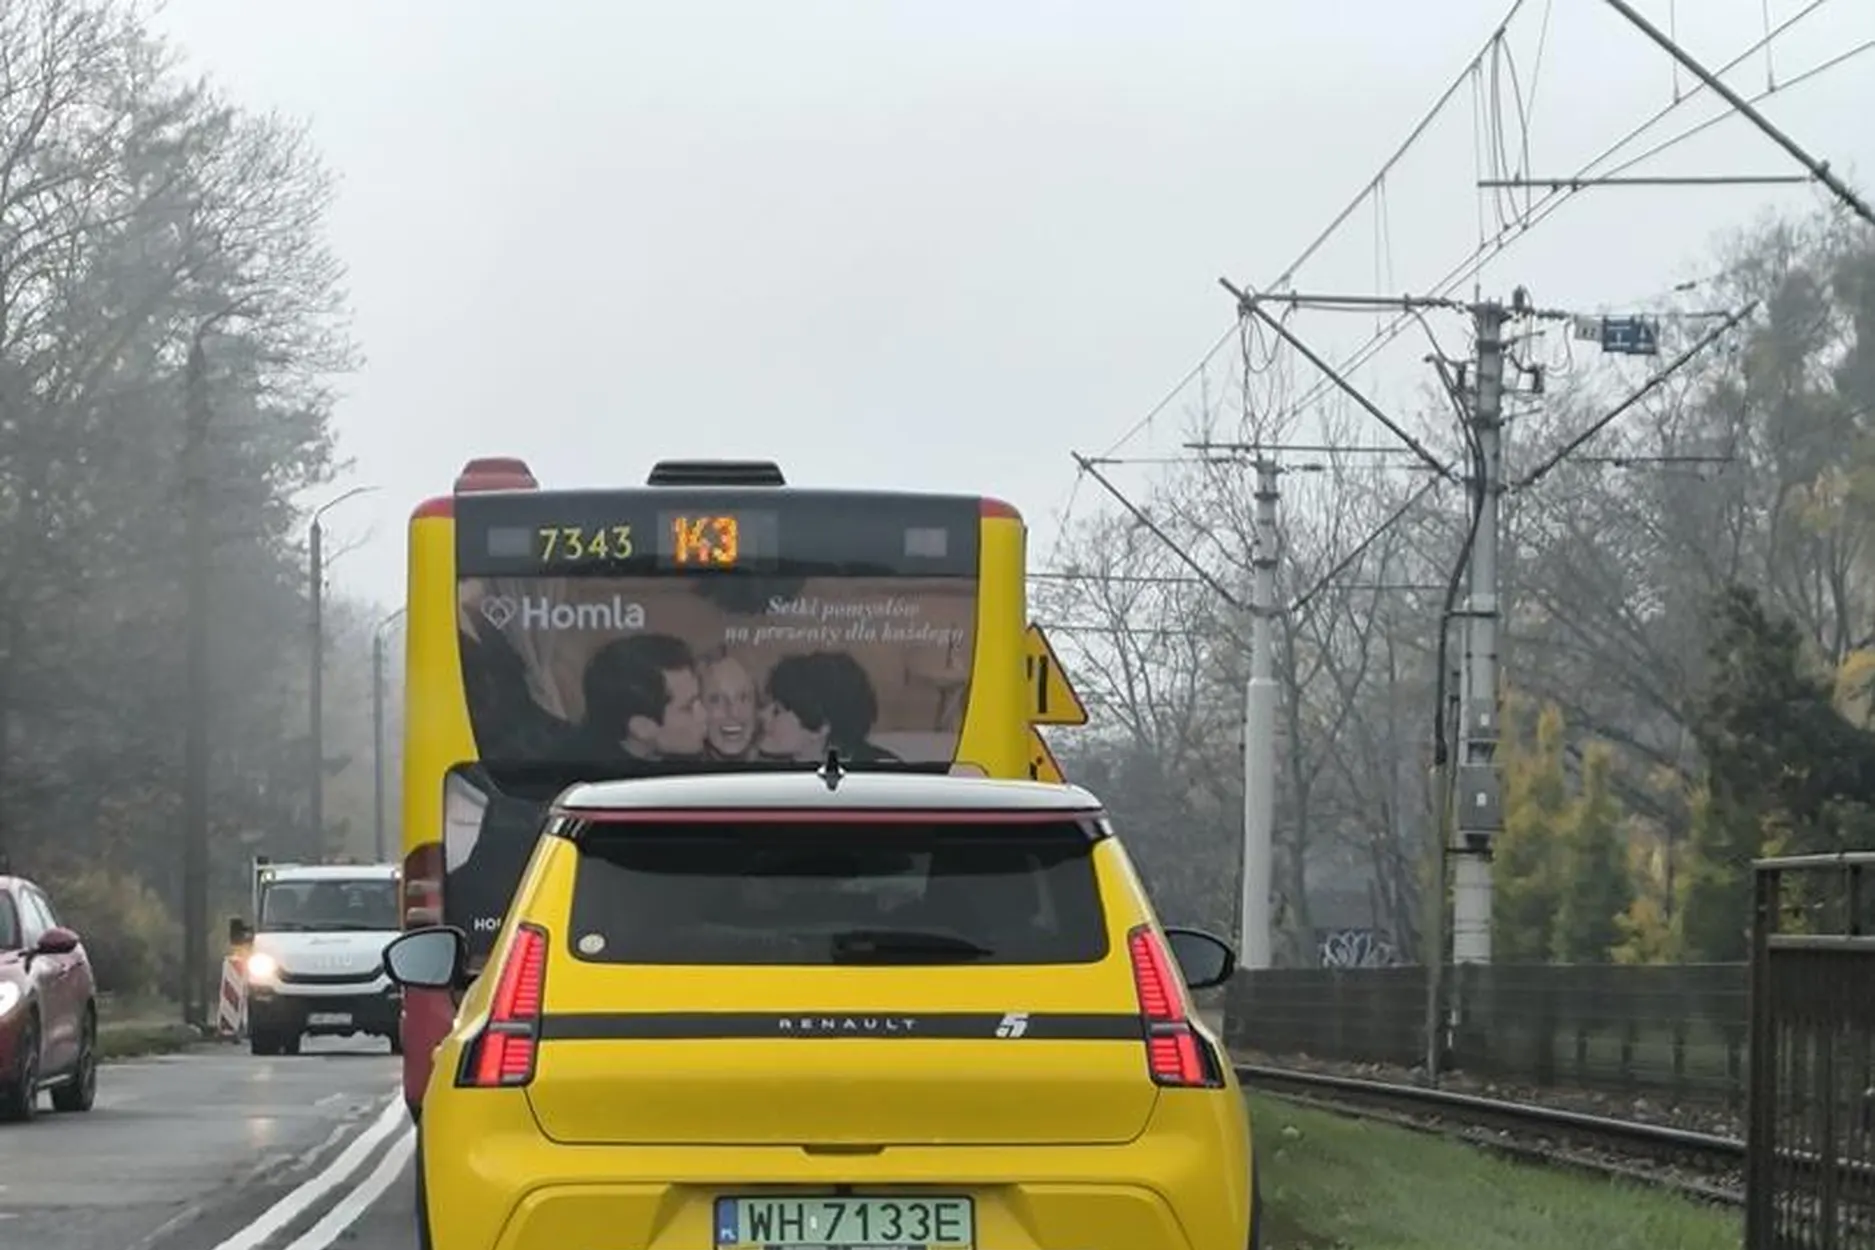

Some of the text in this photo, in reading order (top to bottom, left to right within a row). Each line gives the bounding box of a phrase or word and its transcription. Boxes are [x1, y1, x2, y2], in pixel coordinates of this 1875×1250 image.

[539, 526, 633, 562] 7343
[522, 597, 645, 630] Homla
[474, 917, 501, 931] HO
[779, 1018, 917, 1030] RENAULT
[748, 1203, 960, 1242] WH 7133E
